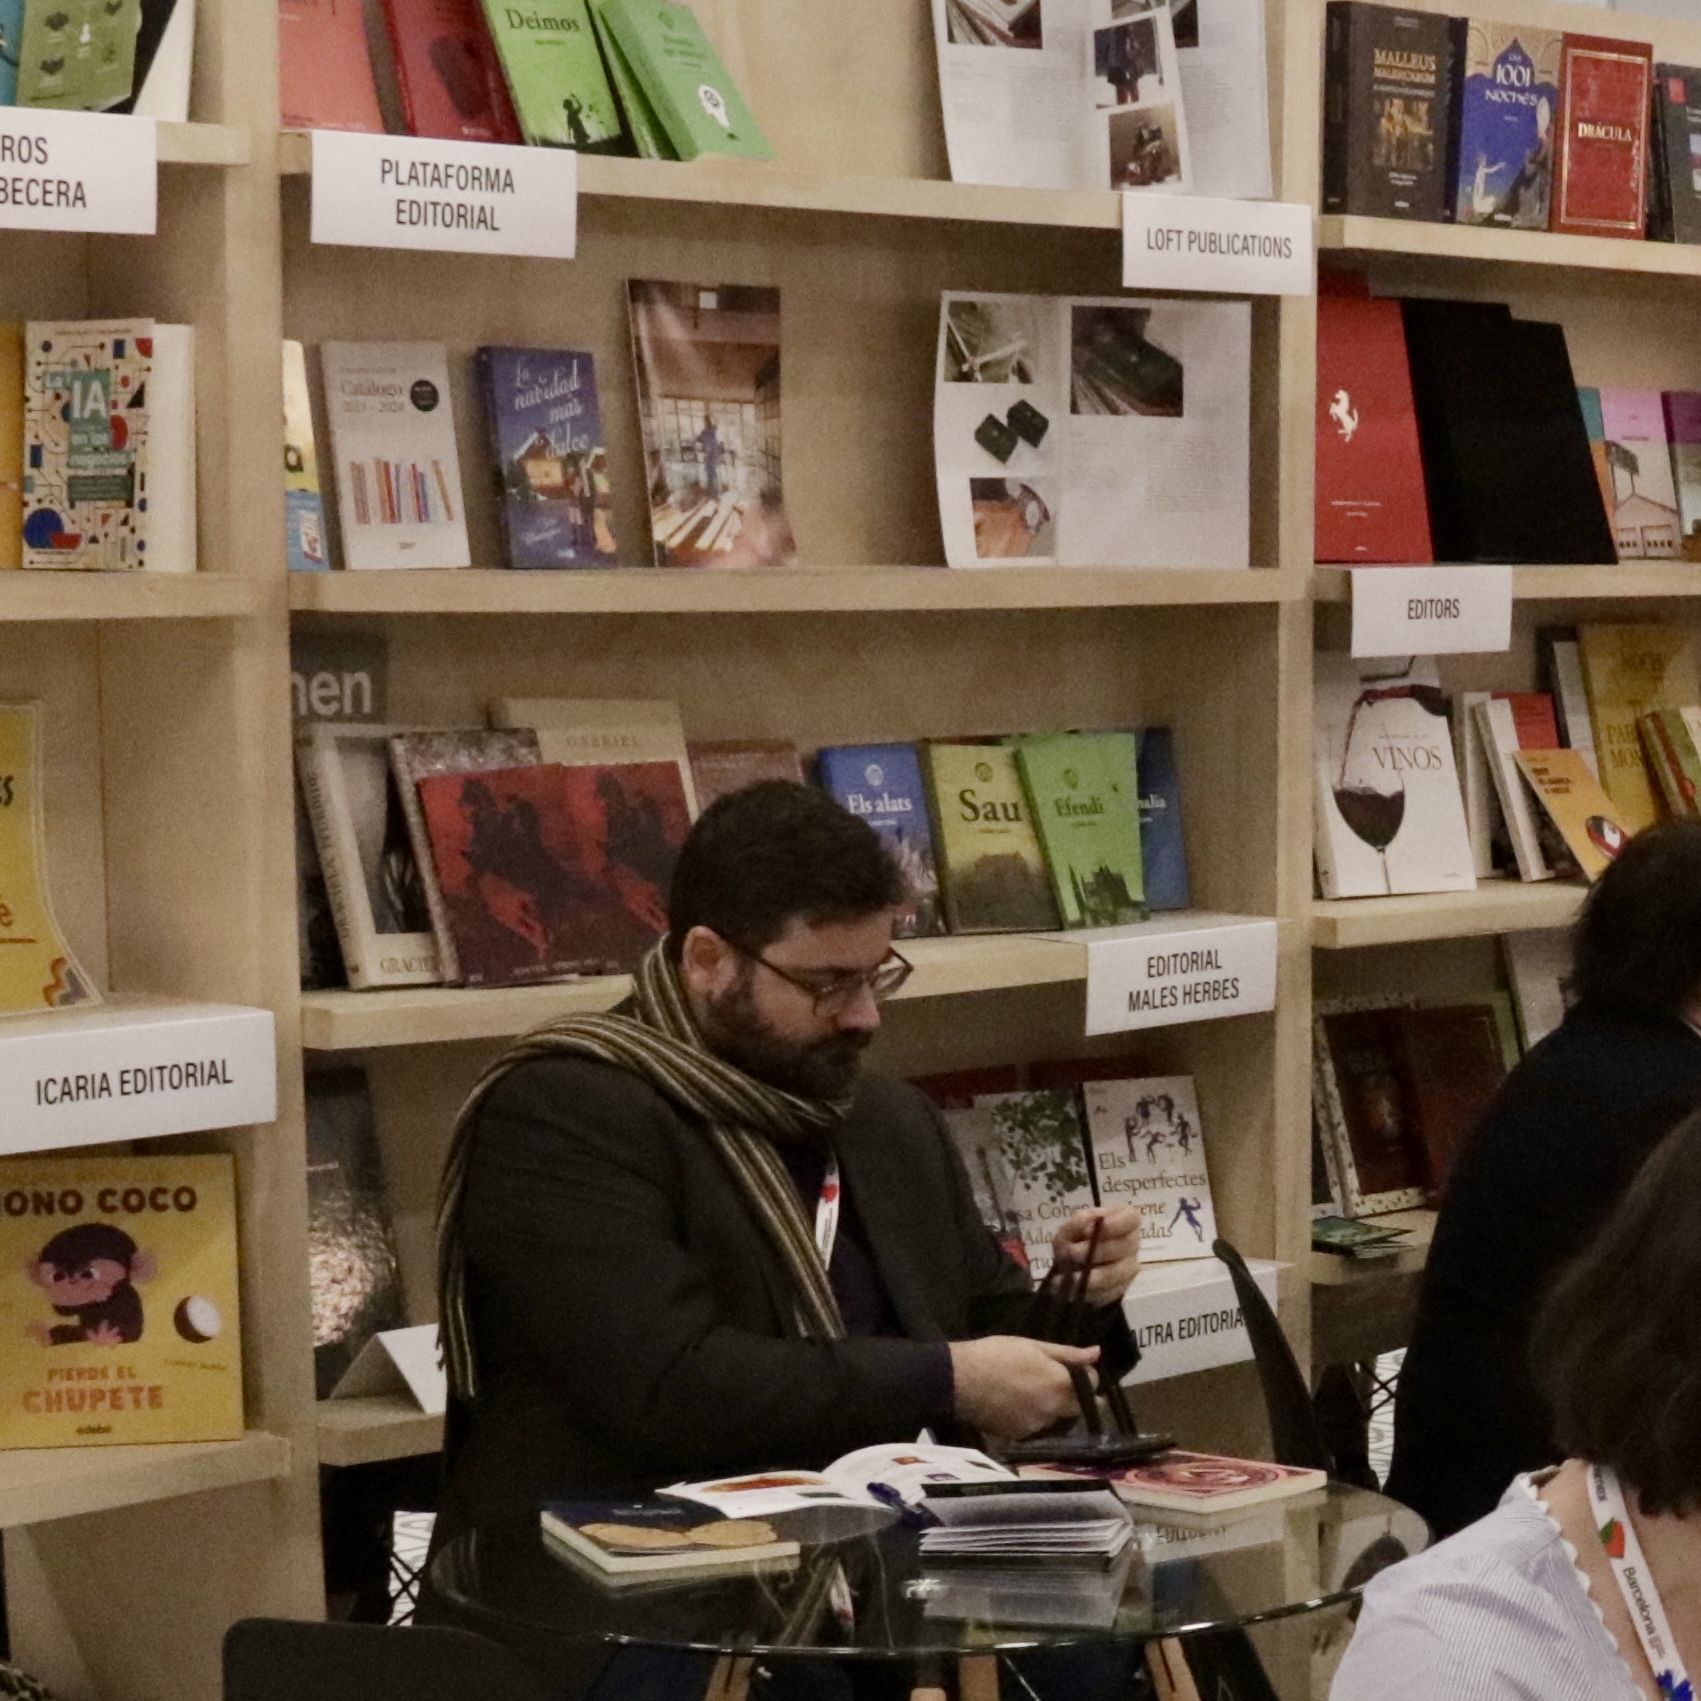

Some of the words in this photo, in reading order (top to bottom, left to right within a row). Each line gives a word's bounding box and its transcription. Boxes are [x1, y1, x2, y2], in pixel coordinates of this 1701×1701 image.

[505, 7, 581, 33] Deimos
[1374, 48, 1436, 70] MALLEUS
[1496, 63, 1531, 87] 1001
[1577, 121, 1633, 142] DRÁCULA
[380, 158, 516, 195] PLATAFORMA
[395, 199, 500, 231] EDITORIAL
[1146, 227, 1184, 252] LOFT
[1187, 230, 1293, 259] PUBLICATIONS
[71, 379, 108, 419] IA
[1407, 598, 1461, 621] EDITORS
[1372, 745, 1442, 771] VINOS
[847, 793, 872, 814] Els
[874, 792, 912, 813] alats
[959, 789, 1023, 823] Sau
[1055, 795, 1105, 817] Efendi
[1147, 949, 1223, 979] EDITORIAL
[1128, 985, 1179, 1013] MALES
[1182, 977, 1240, 1006] HERBES
[36, 1072, 112, 1106] ICARIA
[120, 1058, 233, 1096] EDITORIAL
[1099, 1153, 1126, 1170] Els
[97, 1185, 197, 1213] COCO
[1102, 1171, 1207, 1199] desperfectes
[1178, 1306, 1247, 1340] EDITORIA
[23, 1386, 163, 1414] CHUPETE
[1622, 1567, 1657, 1638] Barcelona
